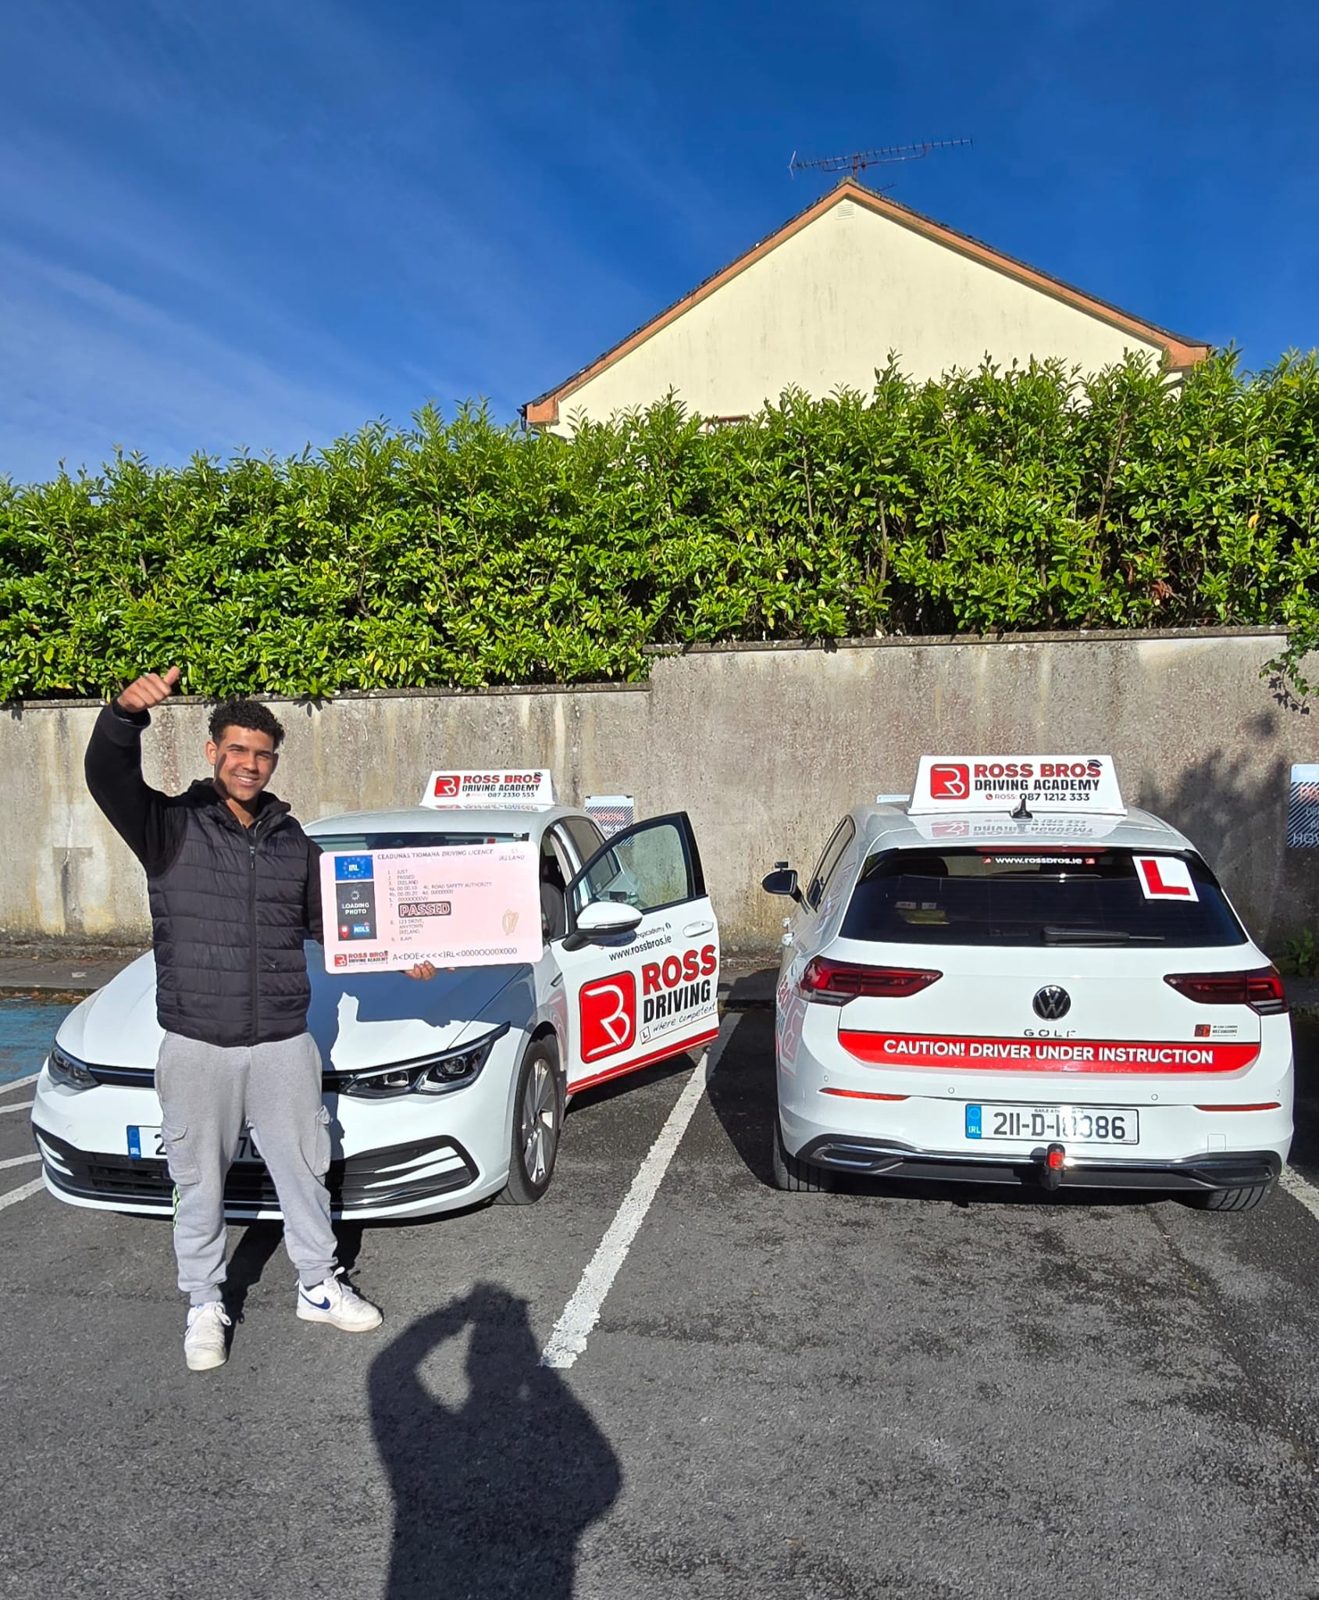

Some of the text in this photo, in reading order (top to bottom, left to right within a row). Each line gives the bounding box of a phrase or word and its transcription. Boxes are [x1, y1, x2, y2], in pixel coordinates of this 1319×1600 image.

[974, 763, 1101, 778] ROSS BROS
[463, 774, 542, 784] ROSS BROS
[974, 779, 1100, 791] DRIVING ACADEMY
[462, 784, 540, 792] DRIVING ACADEMY
[1019, 792, 1041, 801] 087
[1044, 792, 1067, 801] 1212
[1069, 792, 1090, 801] 333
[995, 857, 1083, 865] www.rossbros.ie
[348, 864, 360, 872] IRL
[1140, 859, 1191, 896] L
[400, 903, 450, 917] PASSED
[608, 934, 672, 962] www.rossbros.ie
[641, 944, 717, 996] ROSS
[643, 979, 711, 1024] DRIVING
[1023, 1028, 1077, 1038] GOLF
[883, 1039, 1214, 1064] CAUTION! DRIVER UNDER INSTRUCTION
[968, 1126, 982, 1135] IRL
